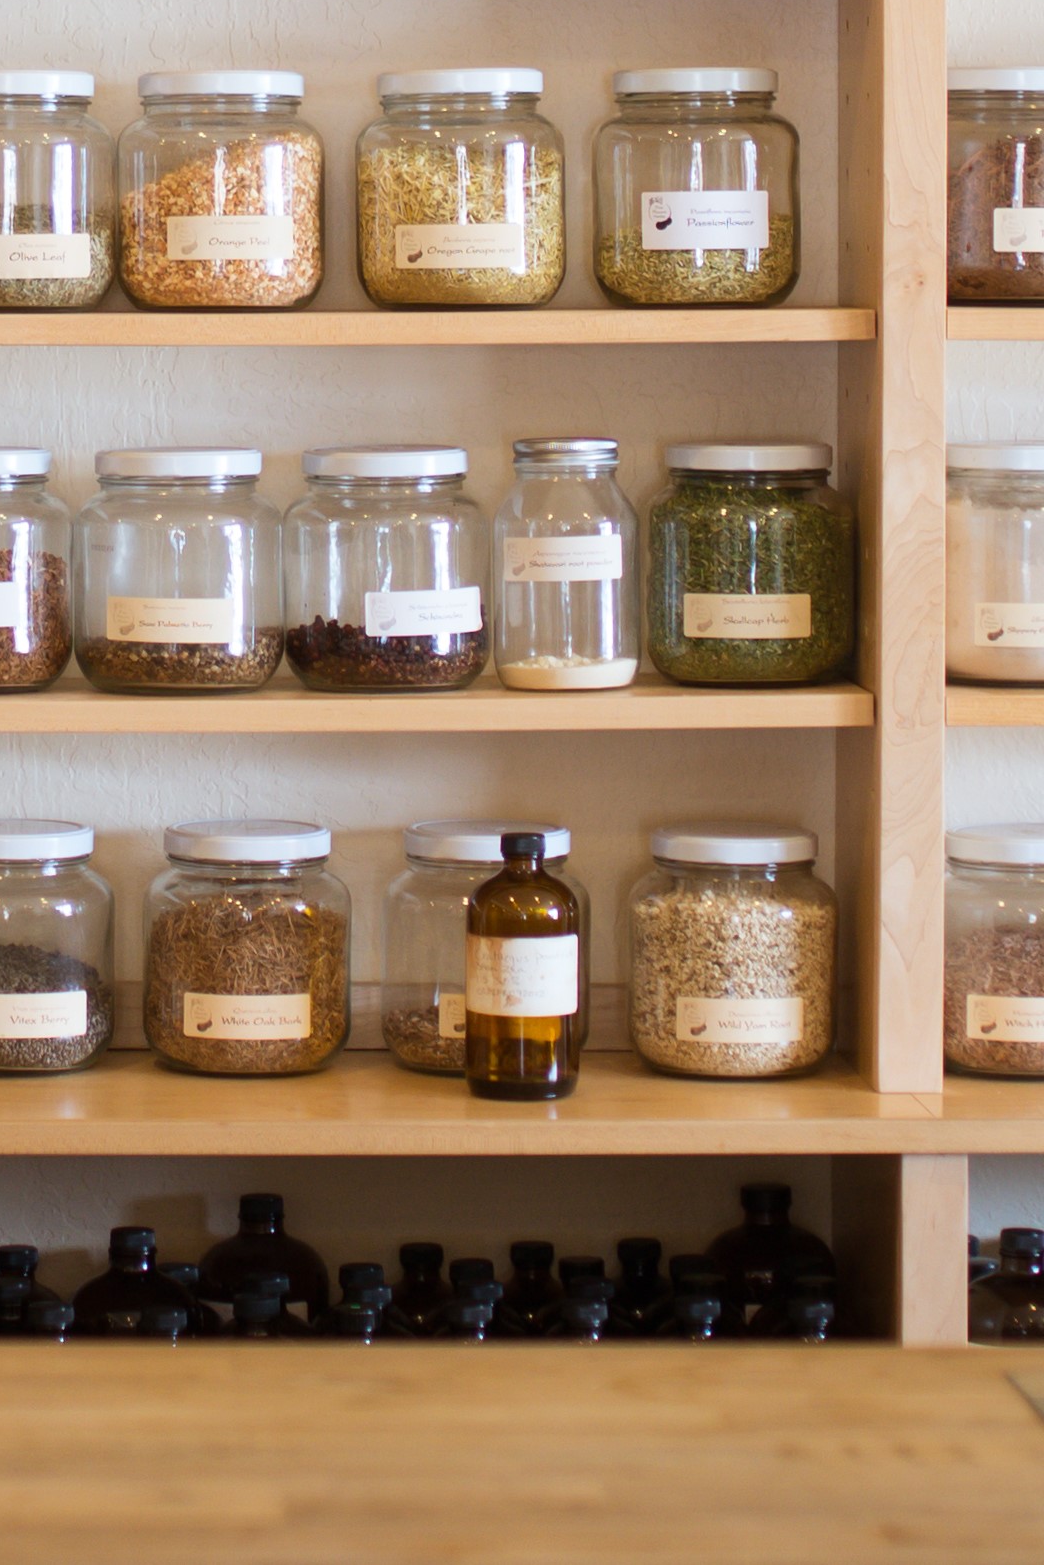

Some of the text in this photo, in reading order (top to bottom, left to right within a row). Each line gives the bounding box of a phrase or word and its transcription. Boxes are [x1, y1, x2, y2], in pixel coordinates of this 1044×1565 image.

[208, 237, 247, 249] Orange
[9, 251, 66, 264] Olive Leaf
[9, 1014, 70, 1026] Vitex Berry
[221, 1016, 251, 1026] White
[253, 1016, 276, 1026] Oak
[717, 1020, 742, 1029] Wild
[744, 1020, 767, 1032] Yam
